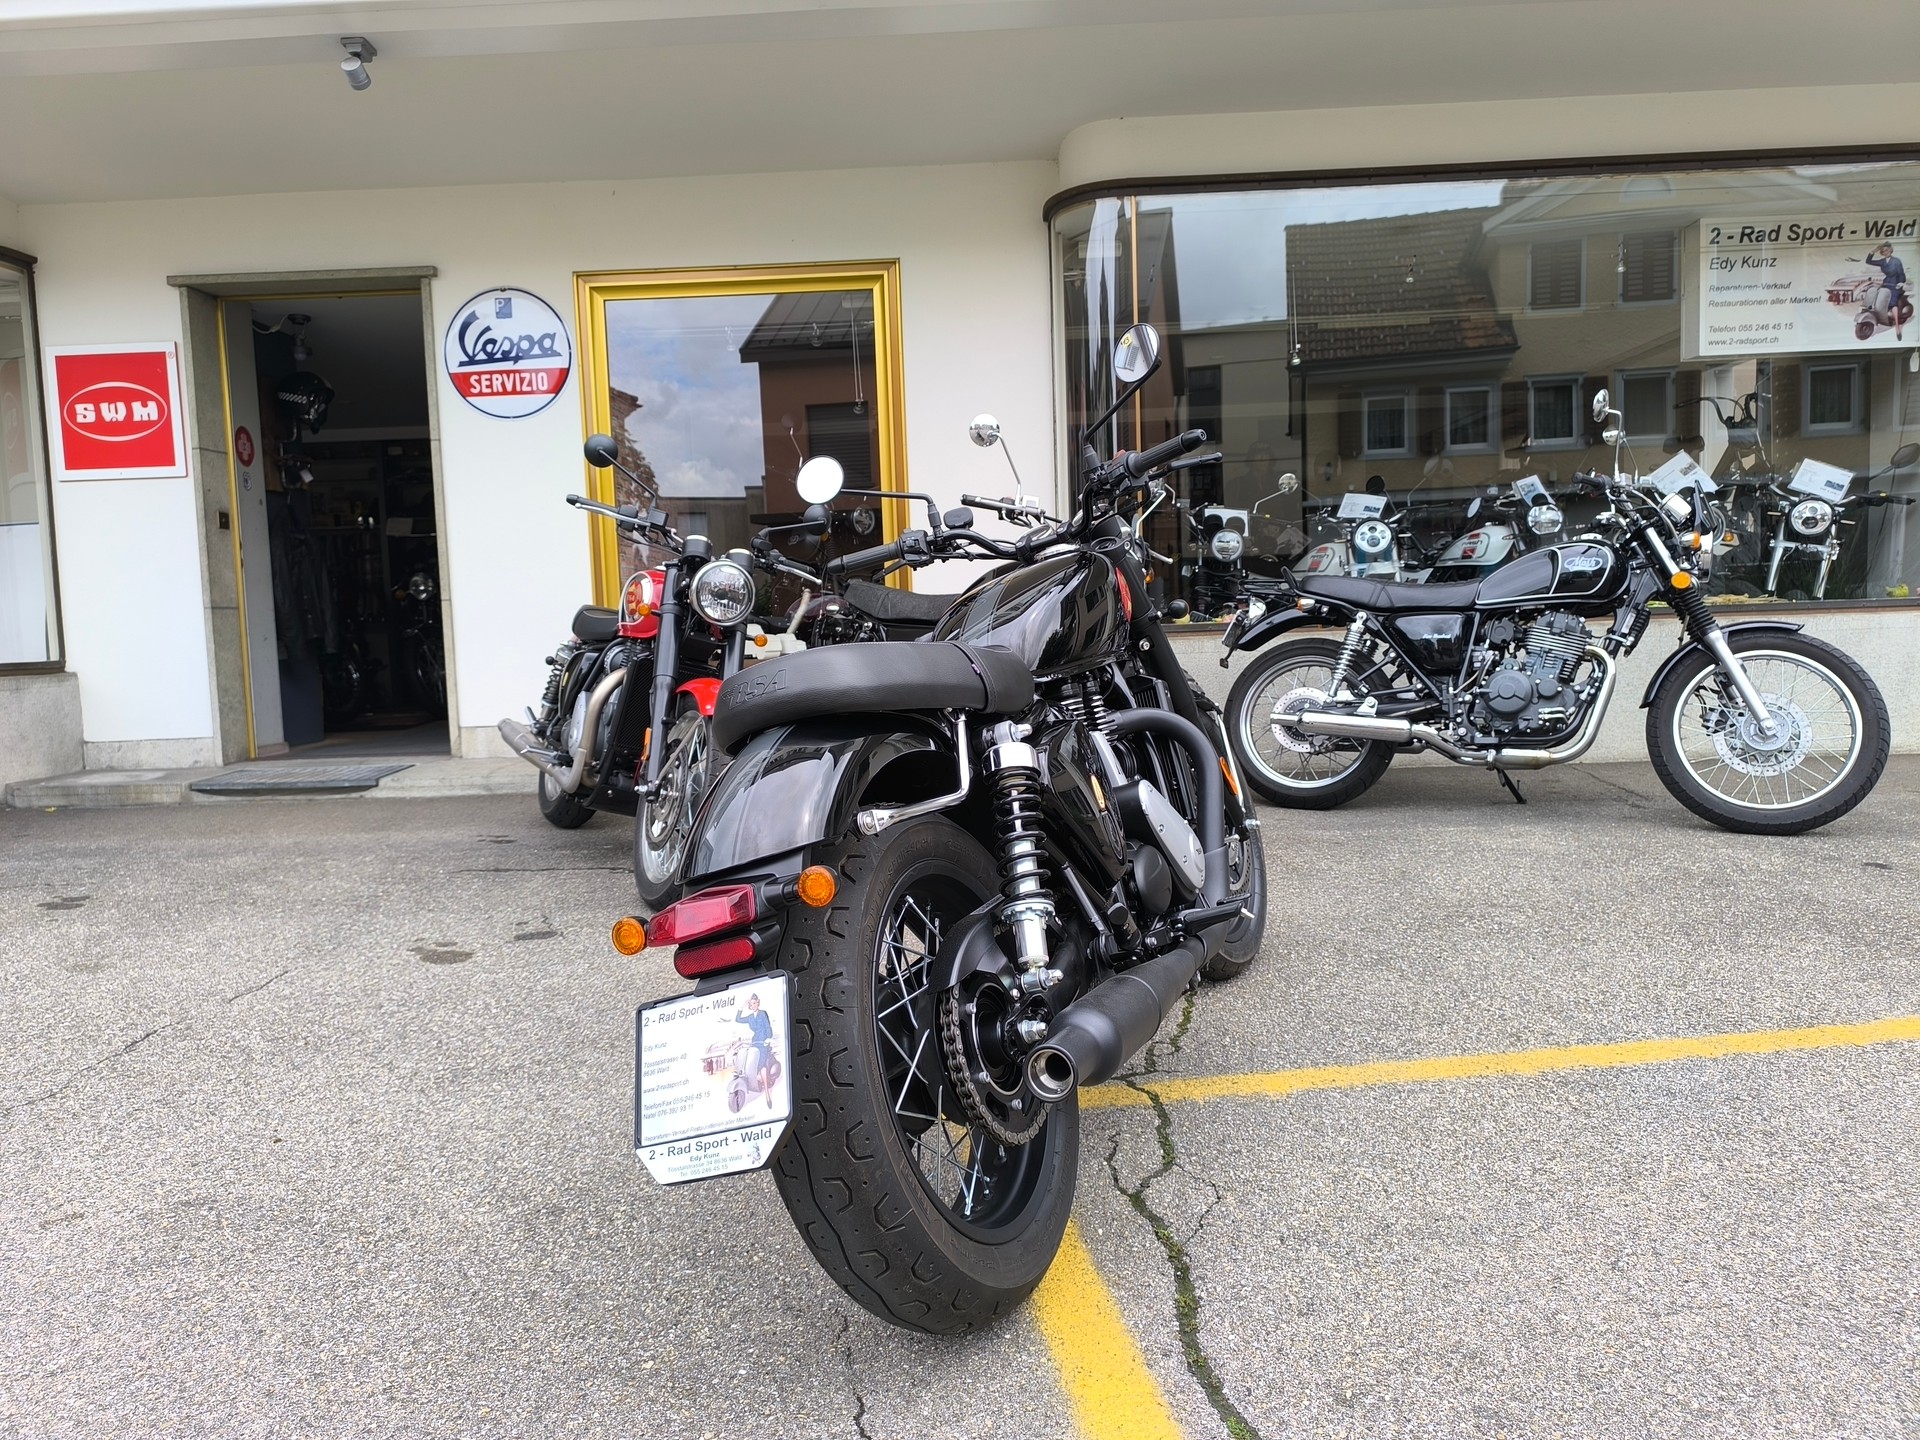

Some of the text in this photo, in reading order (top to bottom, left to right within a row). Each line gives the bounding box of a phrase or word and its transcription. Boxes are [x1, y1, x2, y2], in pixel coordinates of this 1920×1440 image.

[1709, 226, 1721, 245] 2
[1739, 224, 1782, 244] Rad
[1787, 223, 1845, 246] Sport
[1865, 219, 1917, 238] Wald
[1709, 255, 1777, 273] Edy Kunz
[1708, 281, 1792, 294] Reparaturen-Verkauf
[1708, 296, 1822, 308] Restaurationen aller Marken!
[457, 310, 562, 367] Vespa
[1708, 322, 1794, 334] Telefon 055 246 45 15
[1707, 336, 1779, 346] www.2-radsport.ch
[469, 371, 549, 394] SERVIZIO
[74, 401, 159, 424] SWM
[729, 668, 787, 710] BSA
[643, 1017, 650, 1027] 2
[658, 1010, 676, 1023] Rad
[679, 1004, 704, 1019] Sport
[712, 996, 735, 1010] Wald
[648, 1149, 656, 1160] 2
[667, 1143, 691, 1157] Rad
[695, 1136, 729, 1152] Sport
[740, 1127, 772, 1142] Wald
[689, 1151, 720, 1162] Edy Kunz
